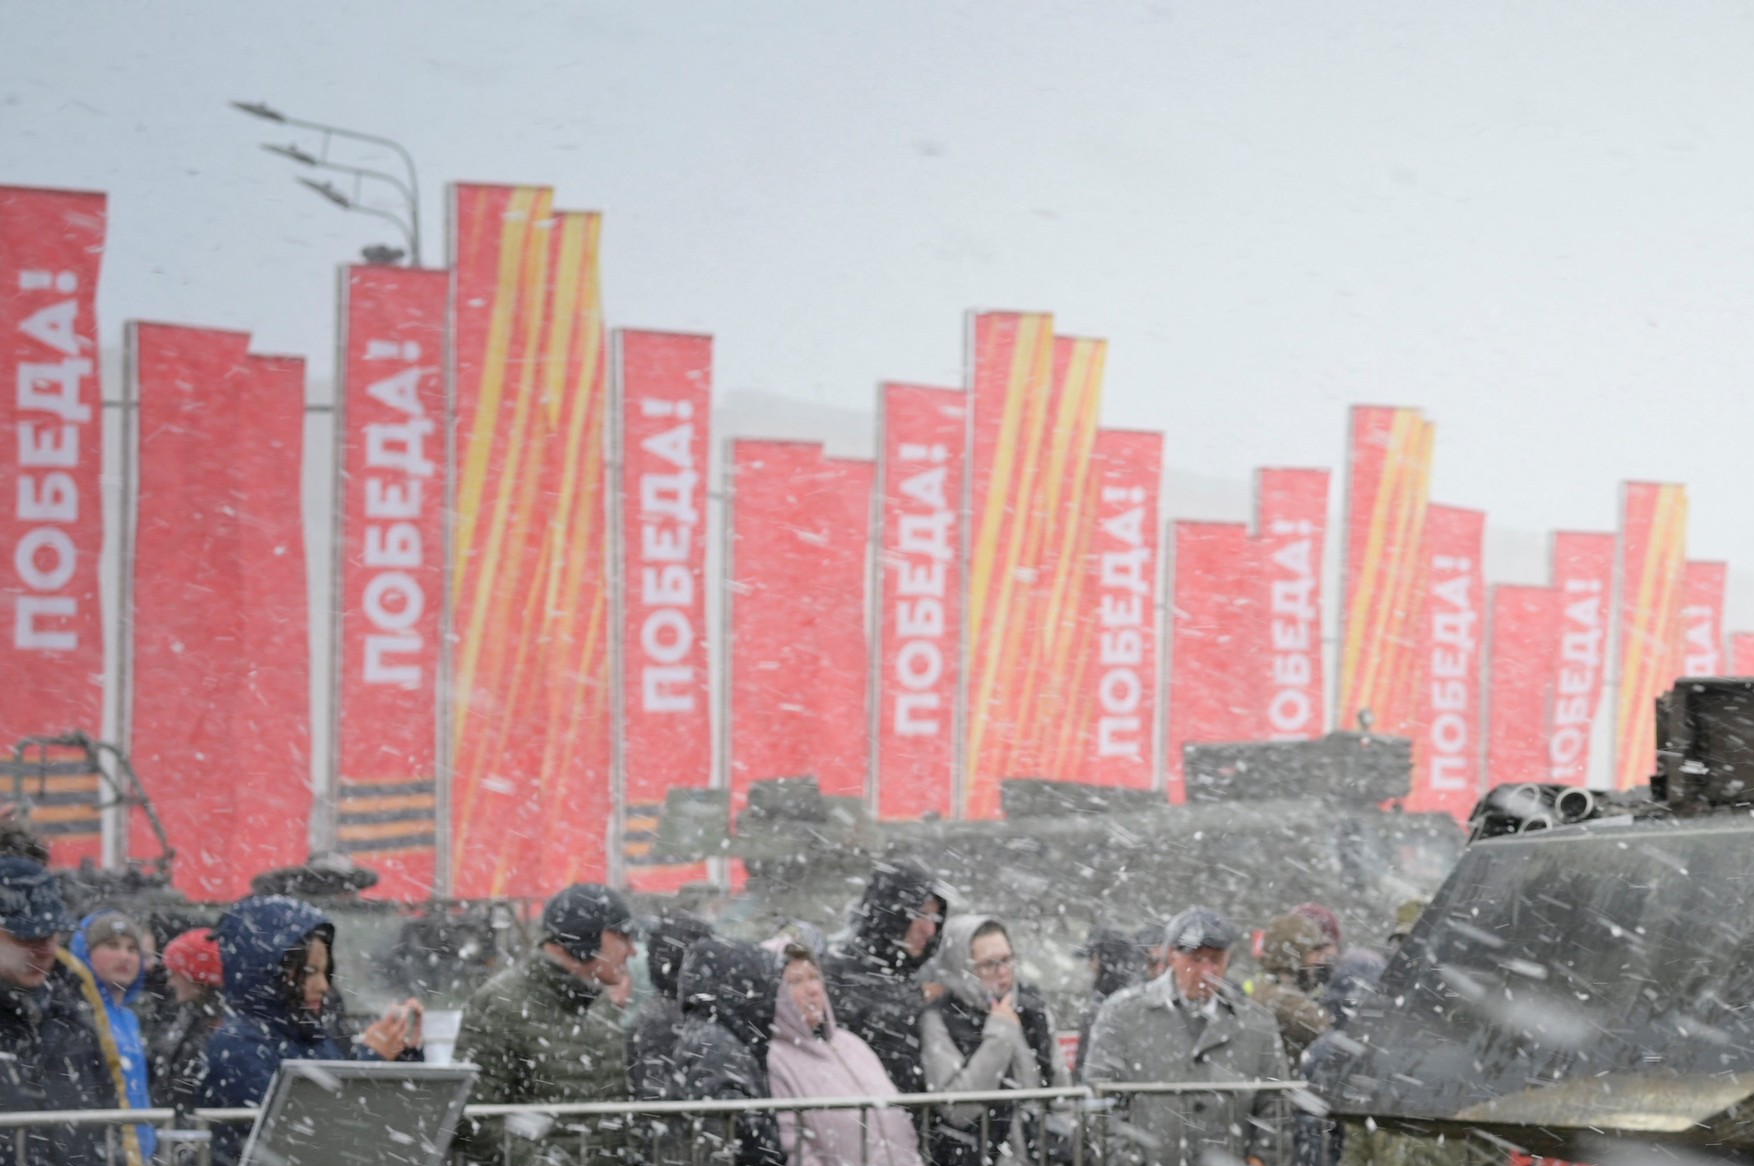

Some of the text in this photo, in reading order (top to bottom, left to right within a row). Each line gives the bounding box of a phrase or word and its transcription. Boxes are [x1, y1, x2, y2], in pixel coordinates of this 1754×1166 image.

[14, 269, 94, 651] ПОБЕДА!
[362, 339, 436, 685] ПОБЕДА!
[641, 398, 698, 712] ПОБЕДА!
[894, 442, 955, 736] ПОБЕДА!
[1098, 484, 1151, 756] ПОБЕДА!
[1268, 519, 1317, 741] ОБЕДА!
[1429, 555, 1478, 790] ПОБЕДА!
